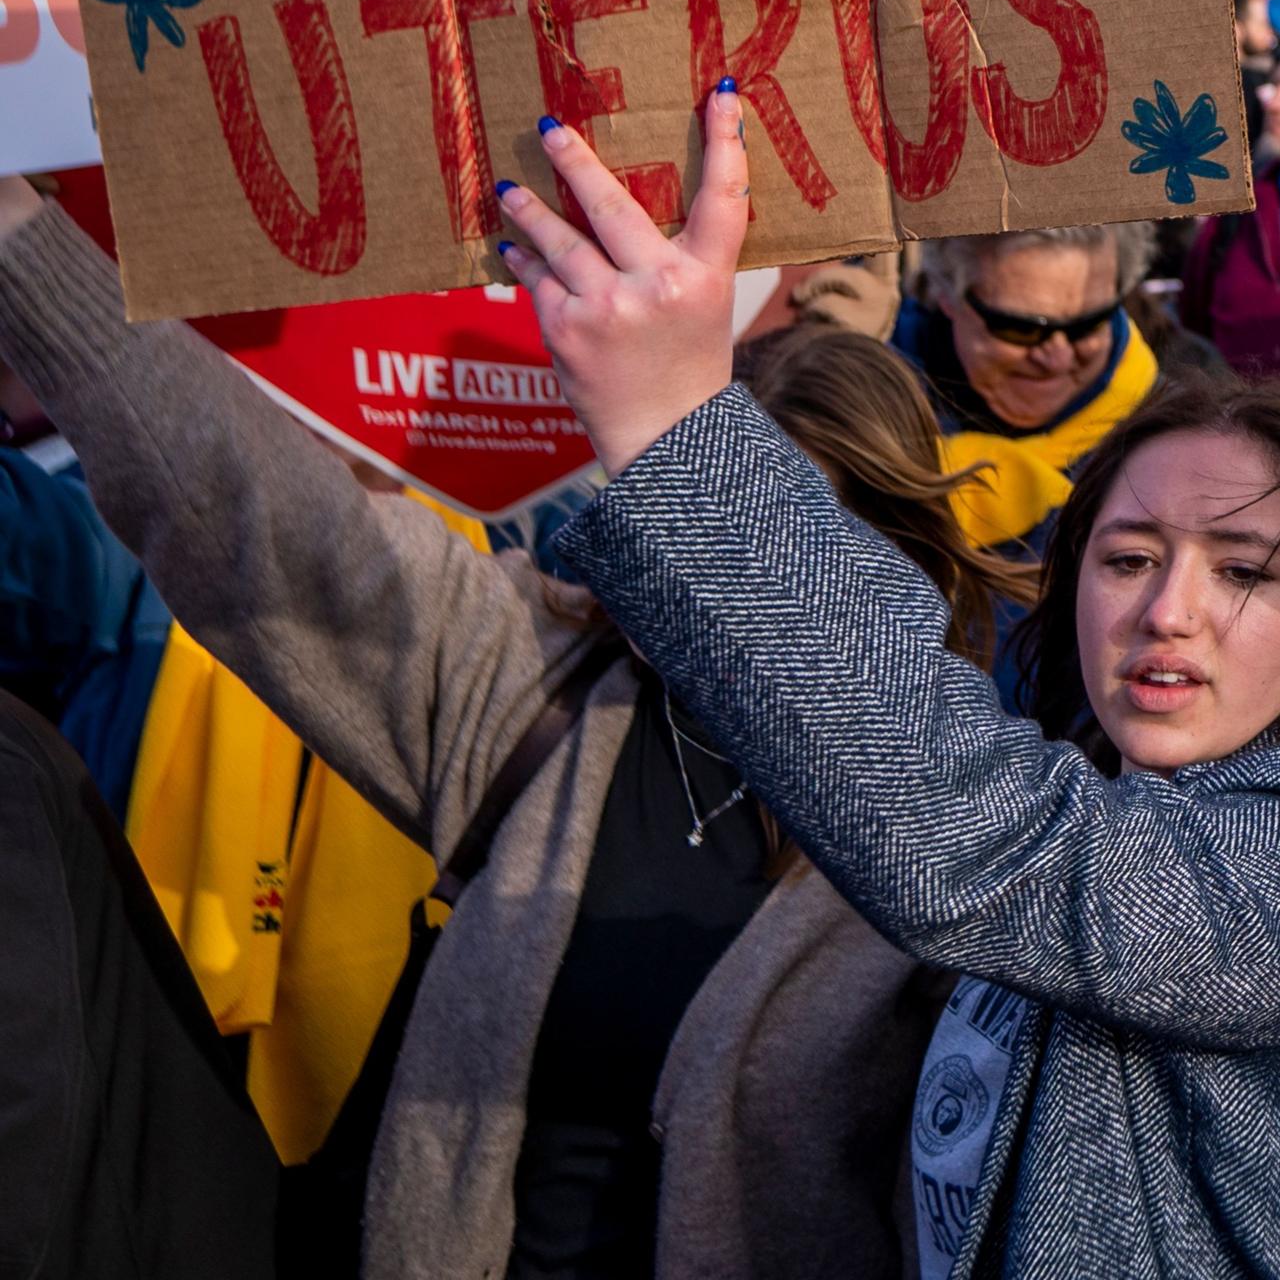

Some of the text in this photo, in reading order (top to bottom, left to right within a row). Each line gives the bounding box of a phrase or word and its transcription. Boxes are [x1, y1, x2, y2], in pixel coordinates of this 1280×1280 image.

[352, 347, 451, 401] LIVE
[358, 403, 407, 428] Text
[407, 408, 500, 434] MARCH
[503, 417, 529, 435] to
